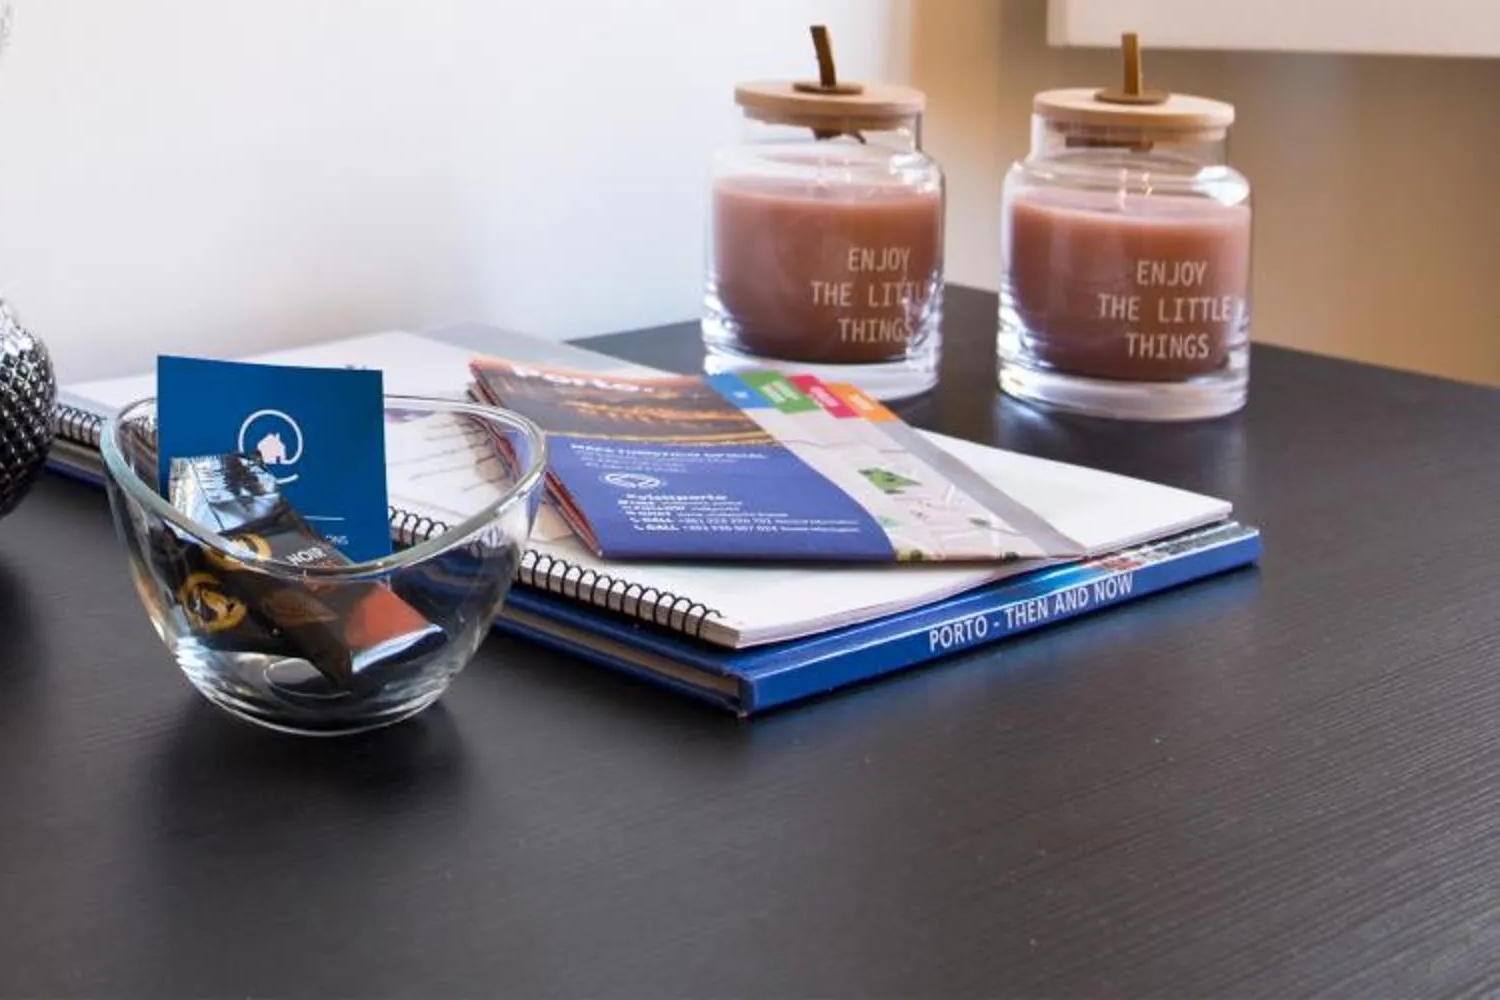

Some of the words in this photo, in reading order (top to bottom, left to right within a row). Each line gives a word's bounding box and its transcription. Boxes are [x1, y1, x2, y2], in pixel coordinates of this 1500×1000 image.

[847, 246, 911, 272] ENJOY
[1137, 260, 1208, 287] ENJOY
[810, 280, 853, 307] THE
[1097, 293, 1141, 322] THE
[1157, 295, 1231, 323] LITTLE
[838, 318, 914, 343] THINGS
[1125, 331, 1210, 359] THINGS
[928, 615, 988, 652] PORTO
[1004, 599, 1050, 630] THEN
[1054, 587, 1090, 615] AND
[1094, 572, 1134, 604] NOW
